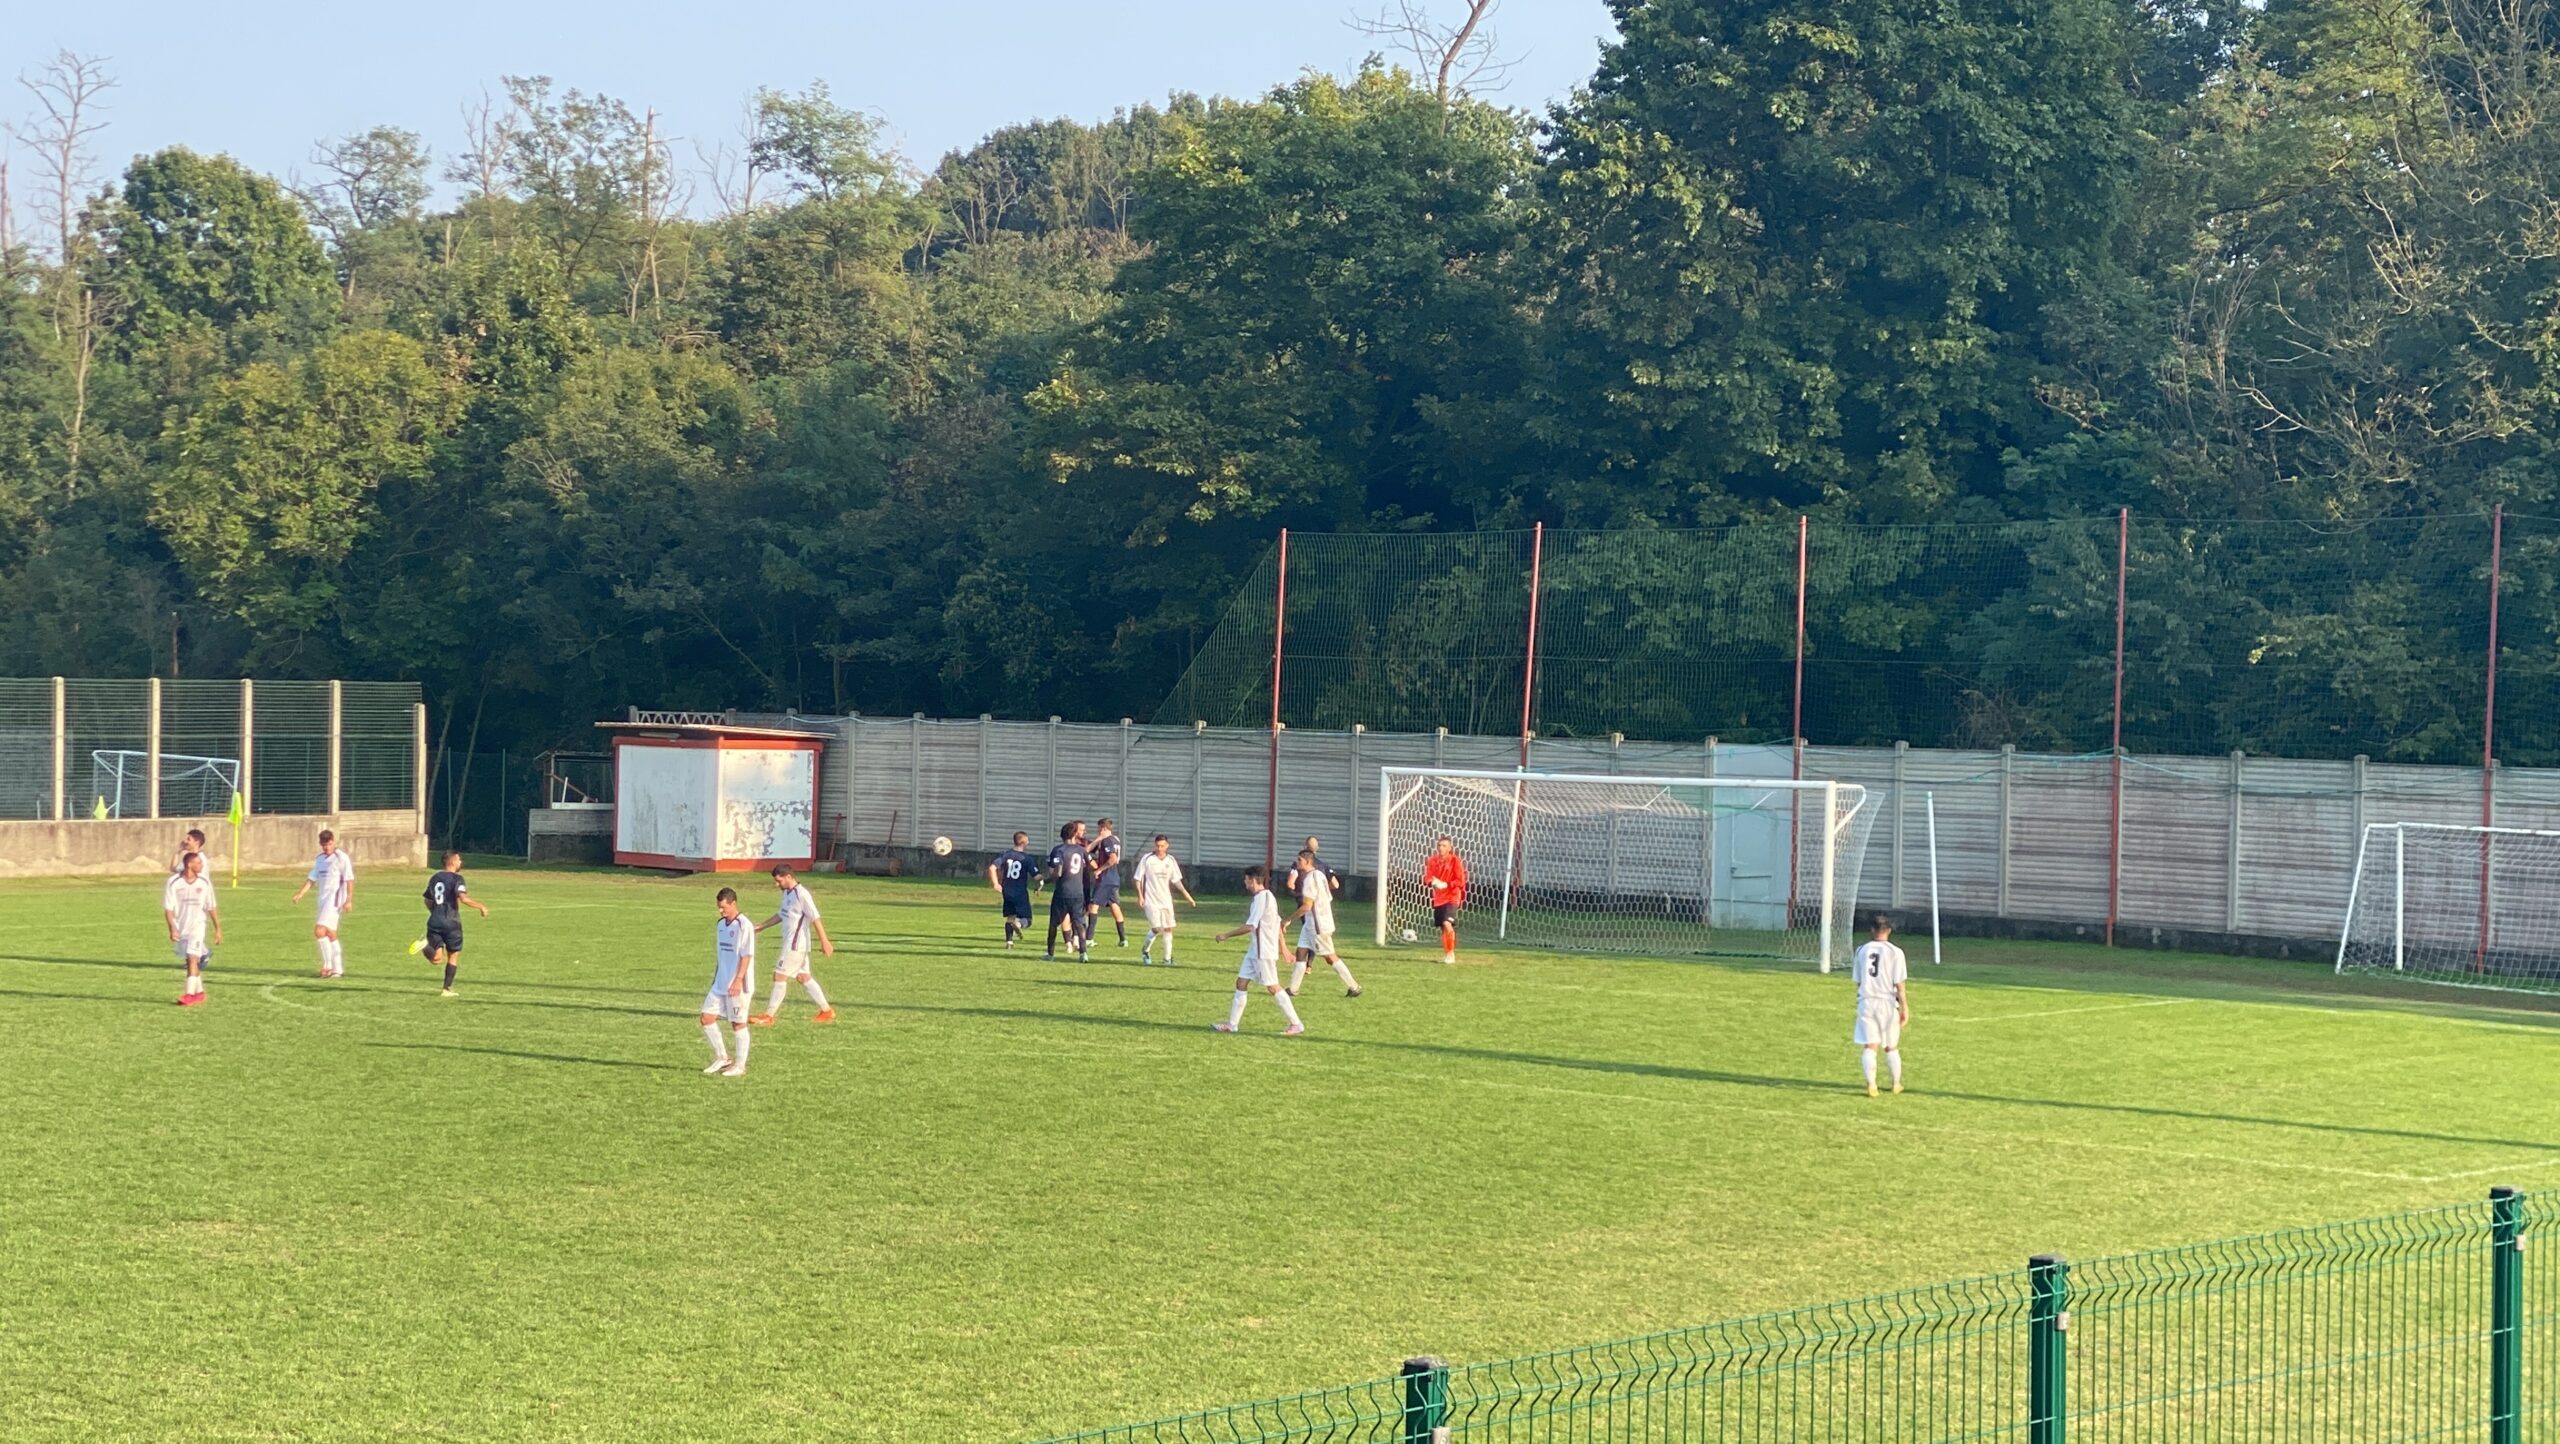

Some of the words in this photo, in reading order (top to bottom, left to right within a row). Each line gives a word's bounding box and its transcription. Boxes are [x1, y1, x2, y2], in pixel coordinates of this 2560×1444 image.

[1006, 858, 1022, 880] 18
[1070, 853, 1082, 875] 9
[434, 881, 445, 905] 8
[1868, 952, 1880, 978] 3
[733, 1006, 740, 1016] 17
